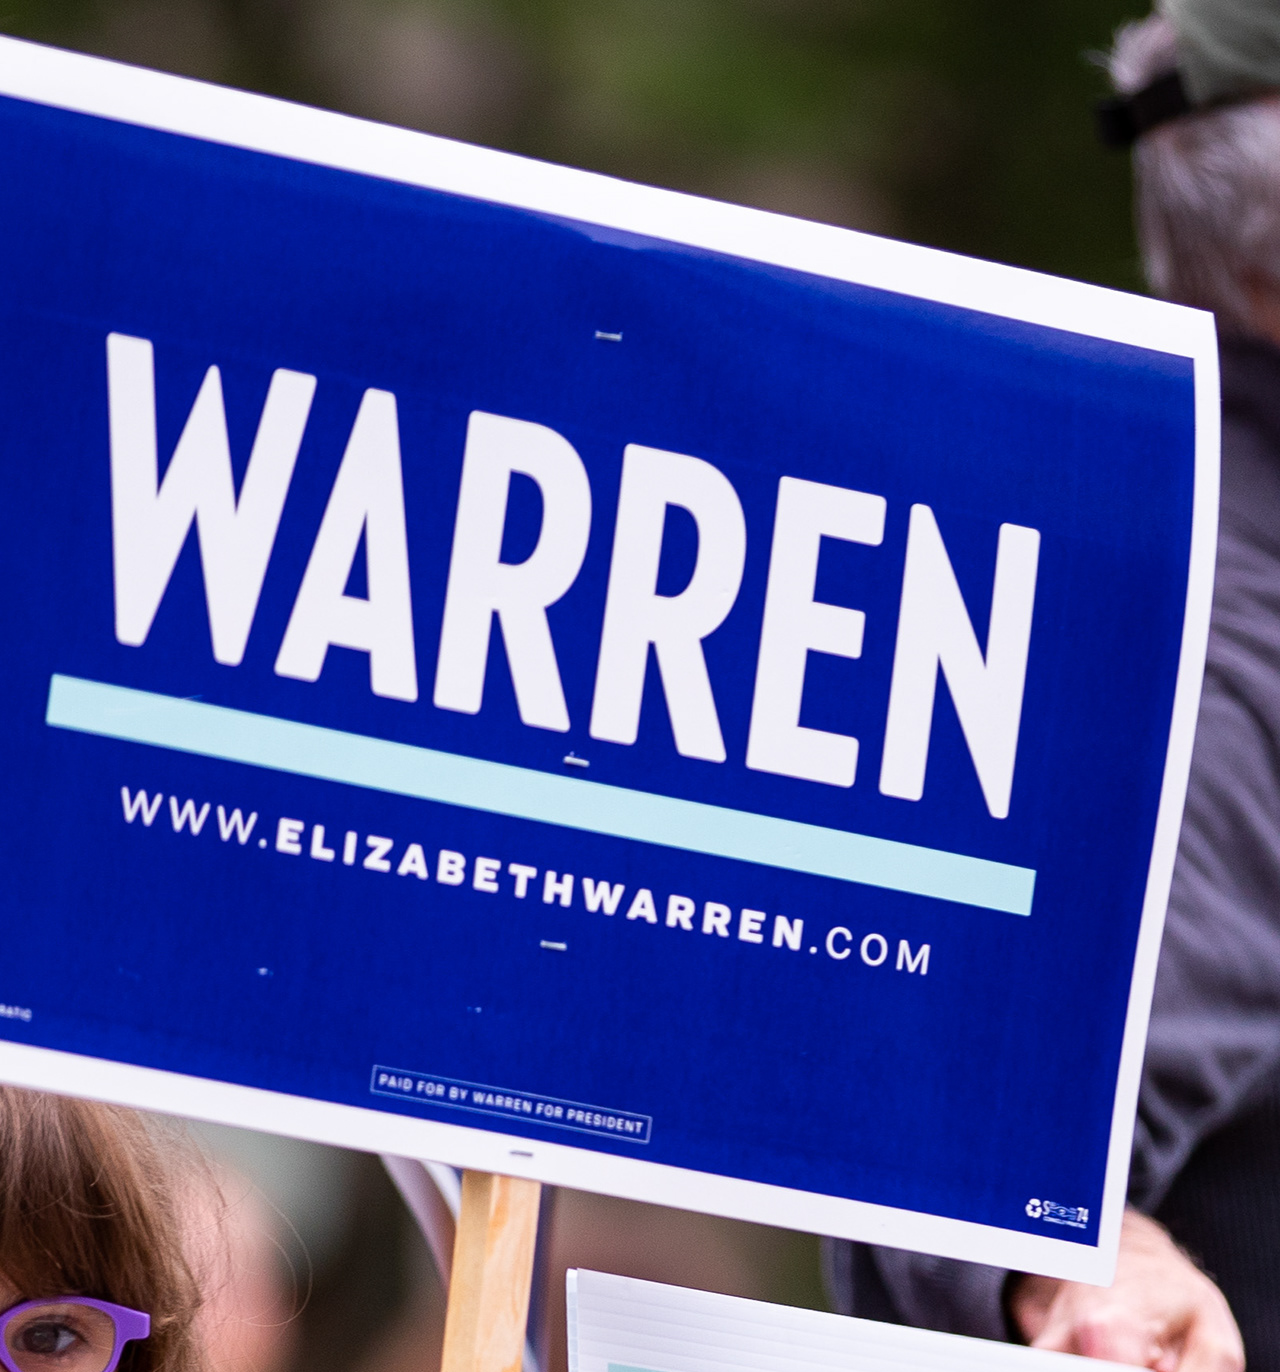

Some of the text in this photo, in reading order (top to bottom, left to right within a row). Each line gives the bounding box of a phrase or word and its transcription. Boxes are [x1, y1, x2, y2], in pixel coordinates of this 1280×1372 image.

[106, 331, 1042, 820] WARREN
[121, 786, 932, 975] WWW.ELIZABETHWARREN.COM
[378, 1073, 644, 1134] PAID FOR BY WARREN FOR PRESIDENT
